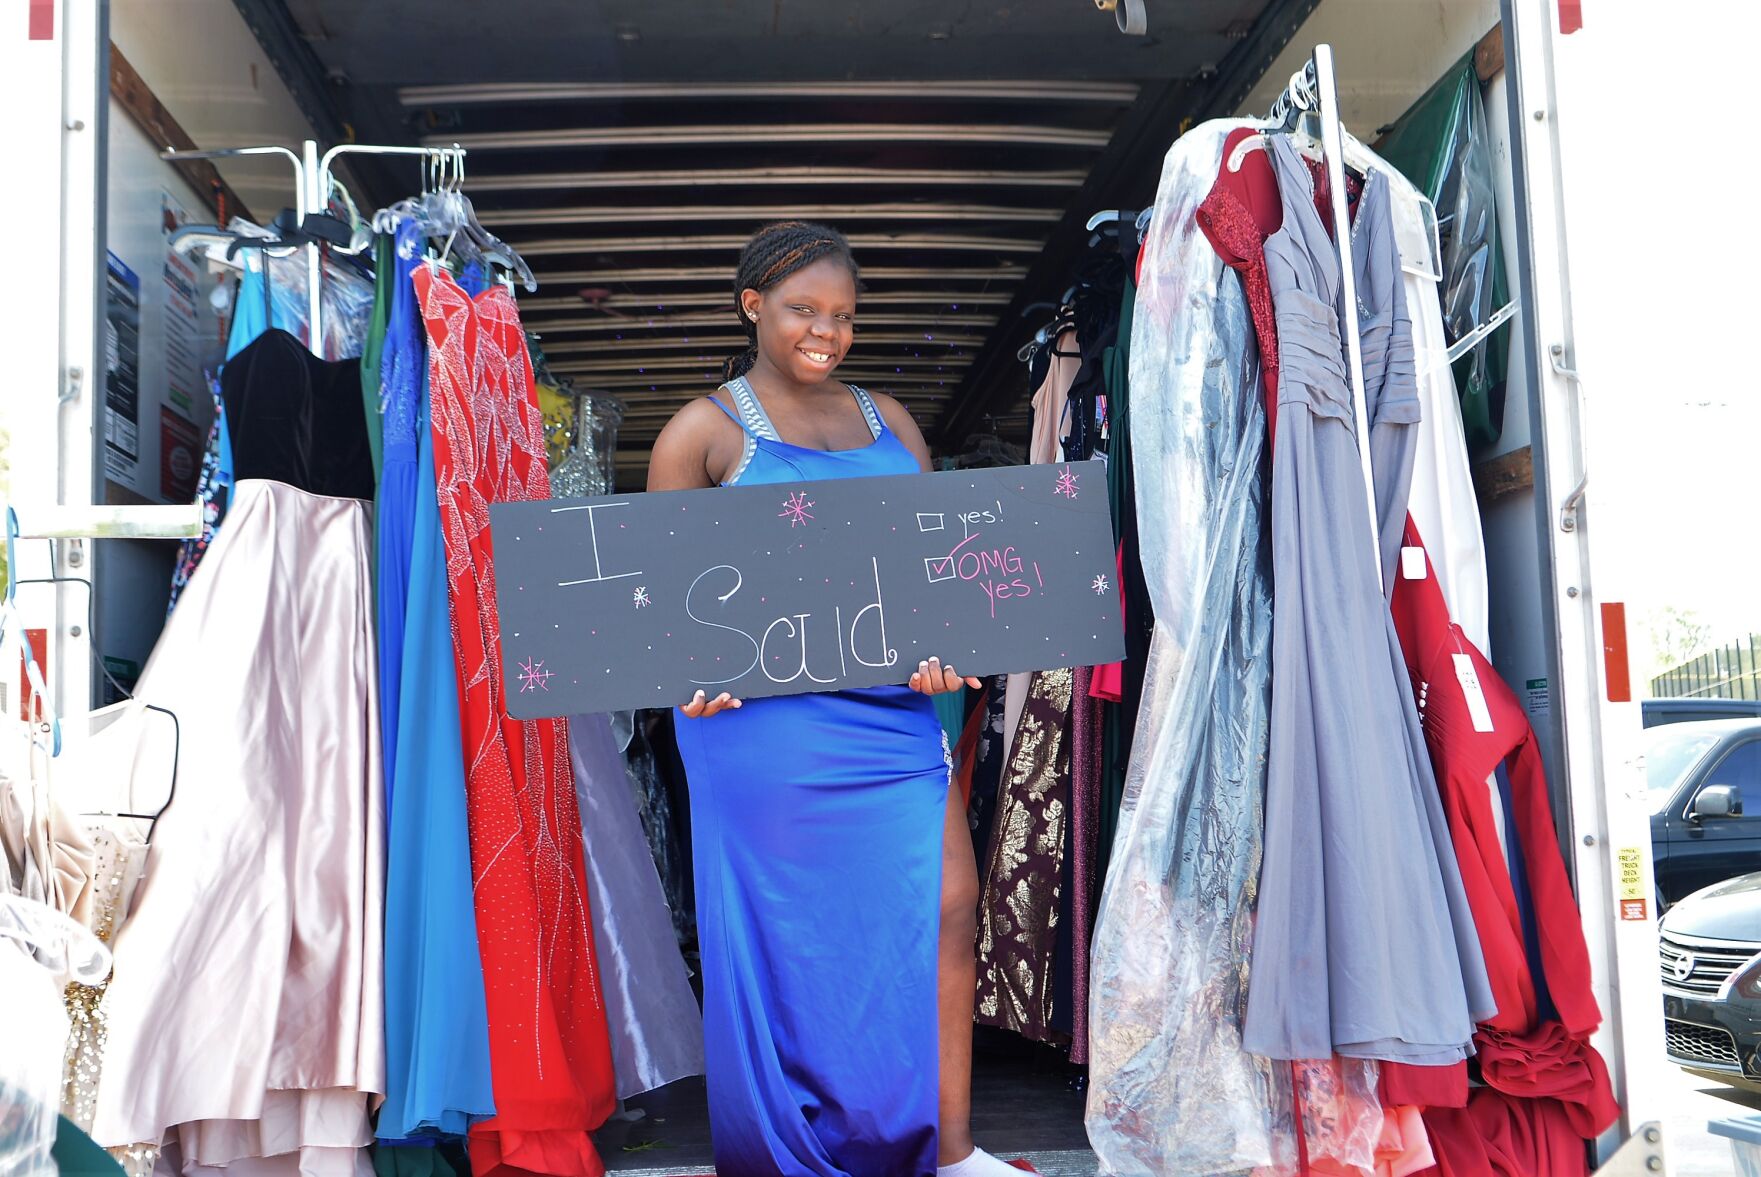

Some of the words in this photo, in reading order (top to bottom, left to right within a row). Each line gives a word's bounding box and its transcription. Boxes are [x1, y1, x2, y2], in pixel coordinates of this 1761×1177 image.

[551, 502, 643, 586] I
[957, 500, 1004, 539] yes!
[958, 546, 1024, 580] OMG
[979, 561, 1045, 619] yes!
[686, 556, 898, 684] Said
